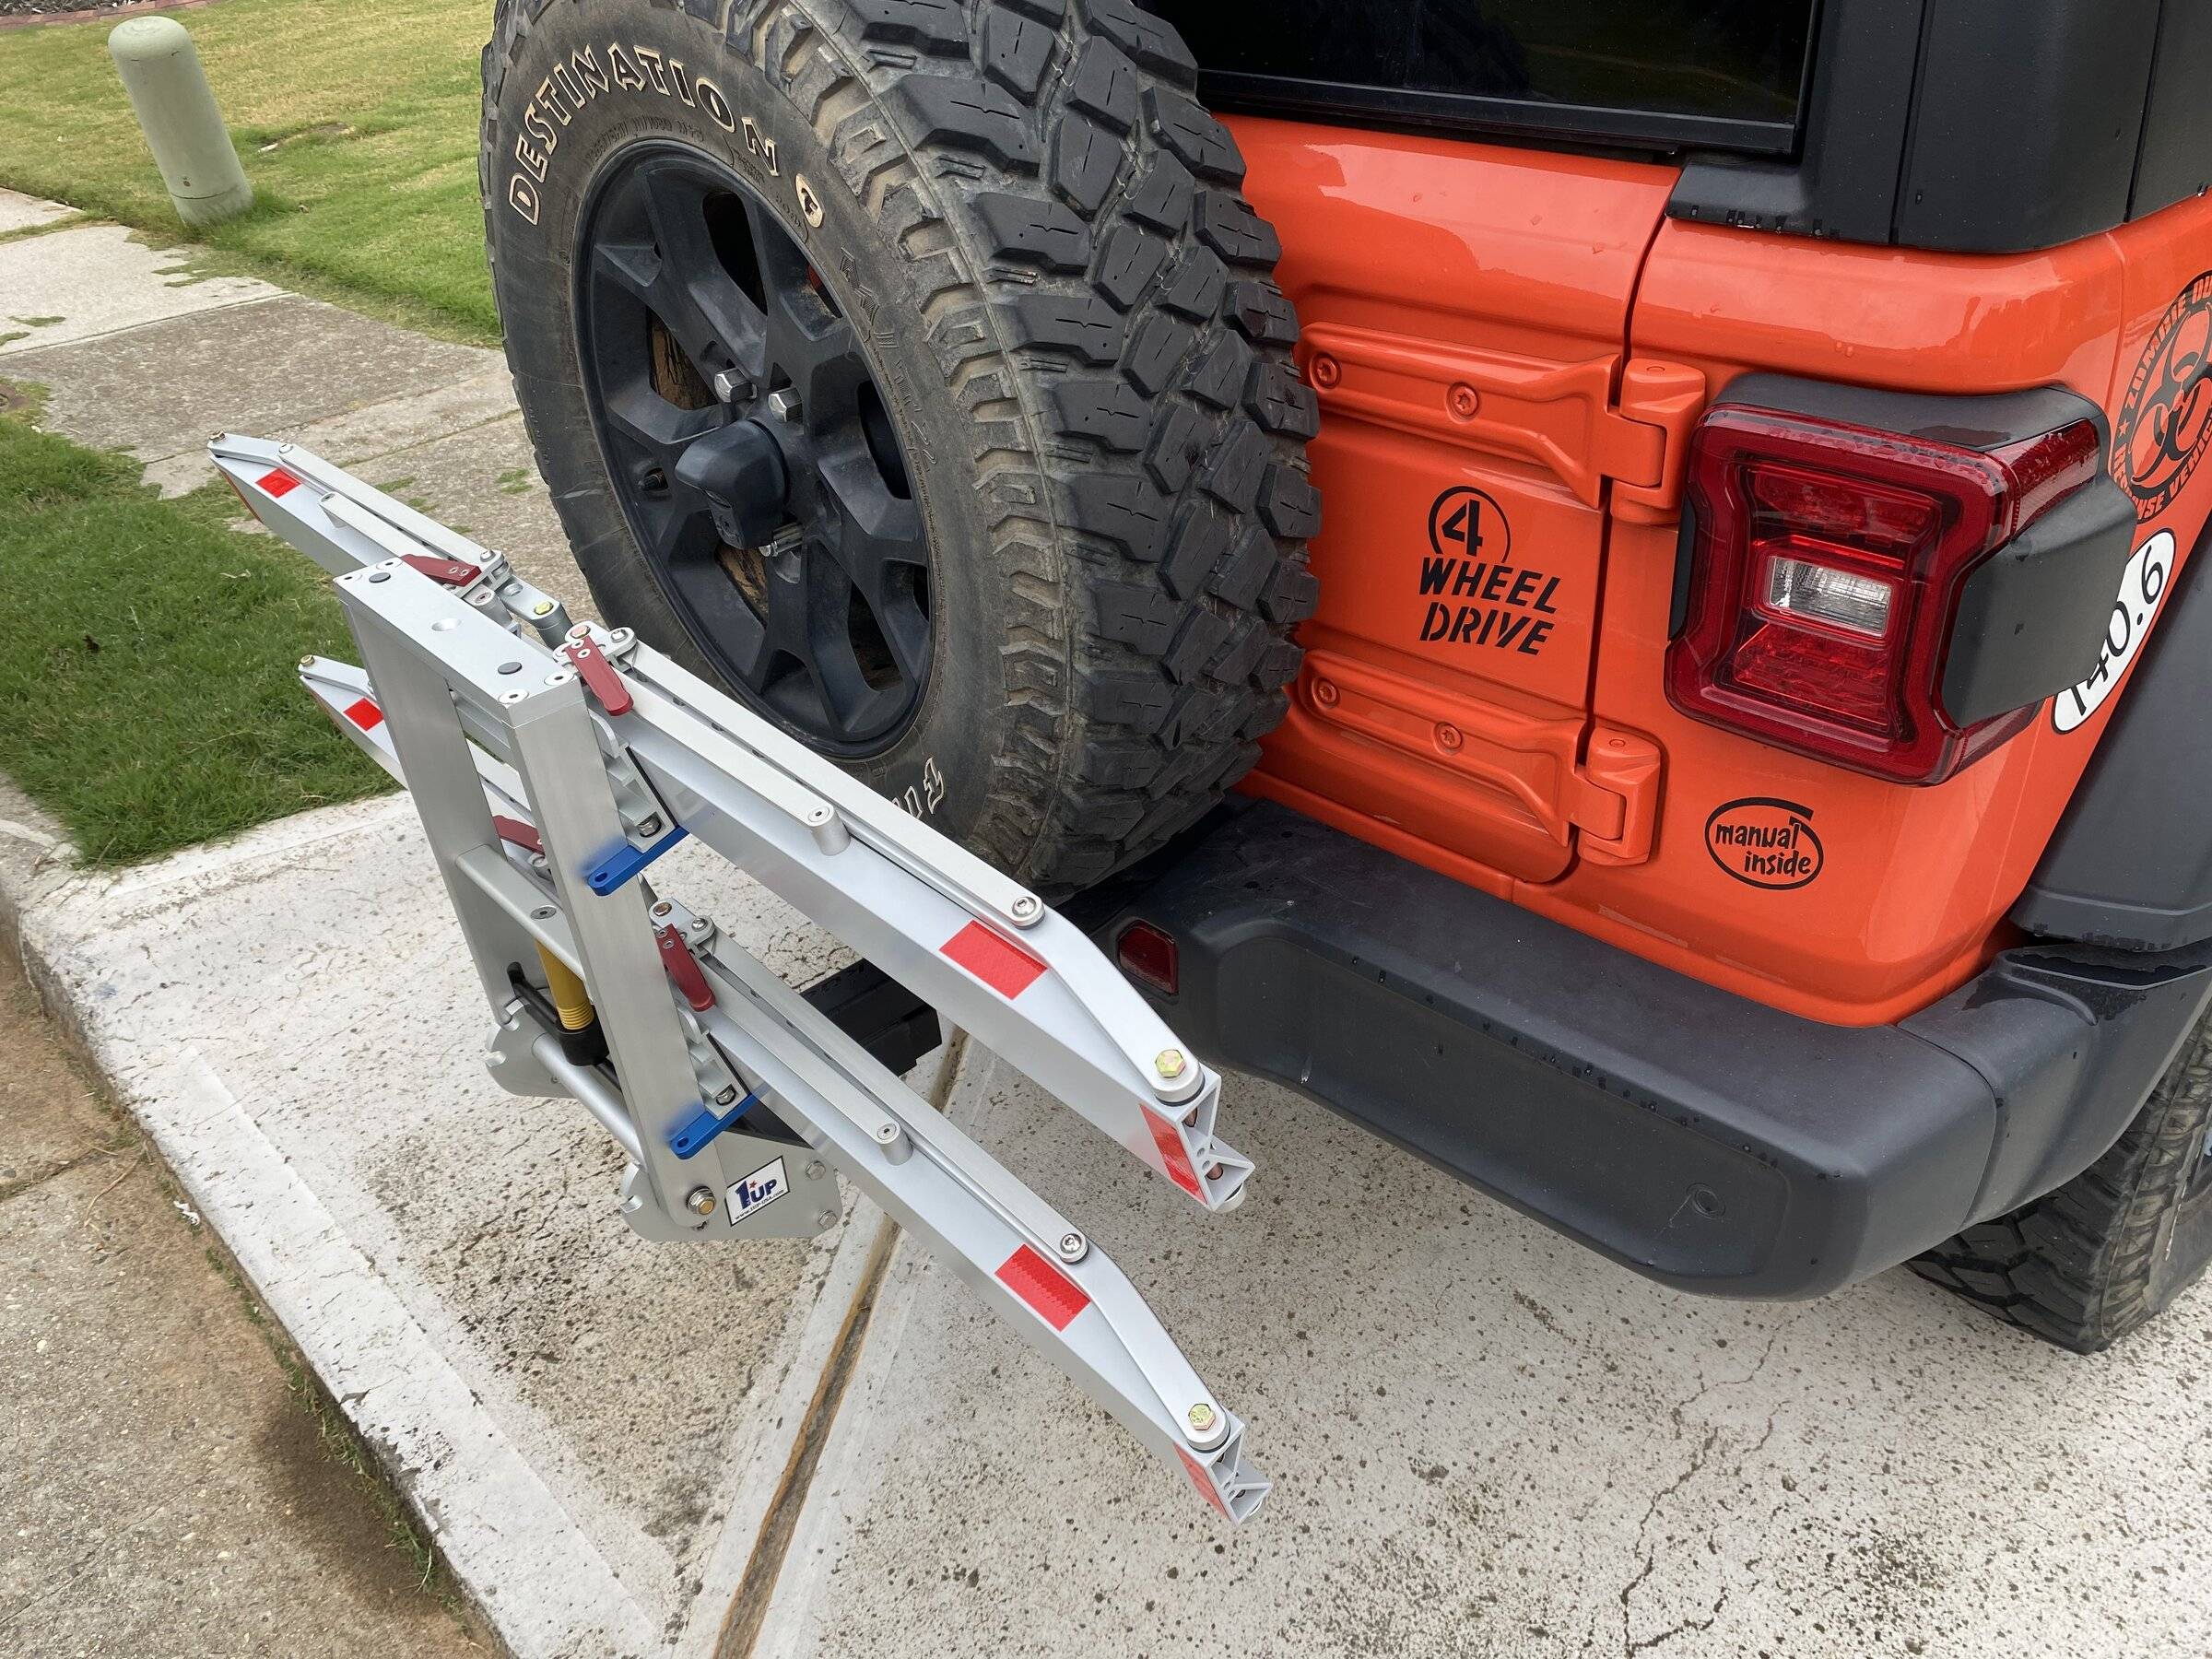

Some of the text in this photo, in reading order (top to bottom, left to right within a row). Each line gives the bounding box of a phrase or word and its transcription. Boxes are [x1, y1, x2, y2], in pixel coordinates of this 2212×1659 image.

[508, 42, 780, 226] DESTINATION
[2124, 293, 2186, 409] ZOMBIE
[1441, 499, 1483, 557] 4
[1419, 557, 1560, 614] WHEEL
[1419, 601, 1555, 655] DRIVE
[2071, 545, 2163, 716] 140.6
[1715, 823, 1800, 850] manual
[1744, 850, 1812, 877] inside
[735, 1179, 778, 1209] 1UP
